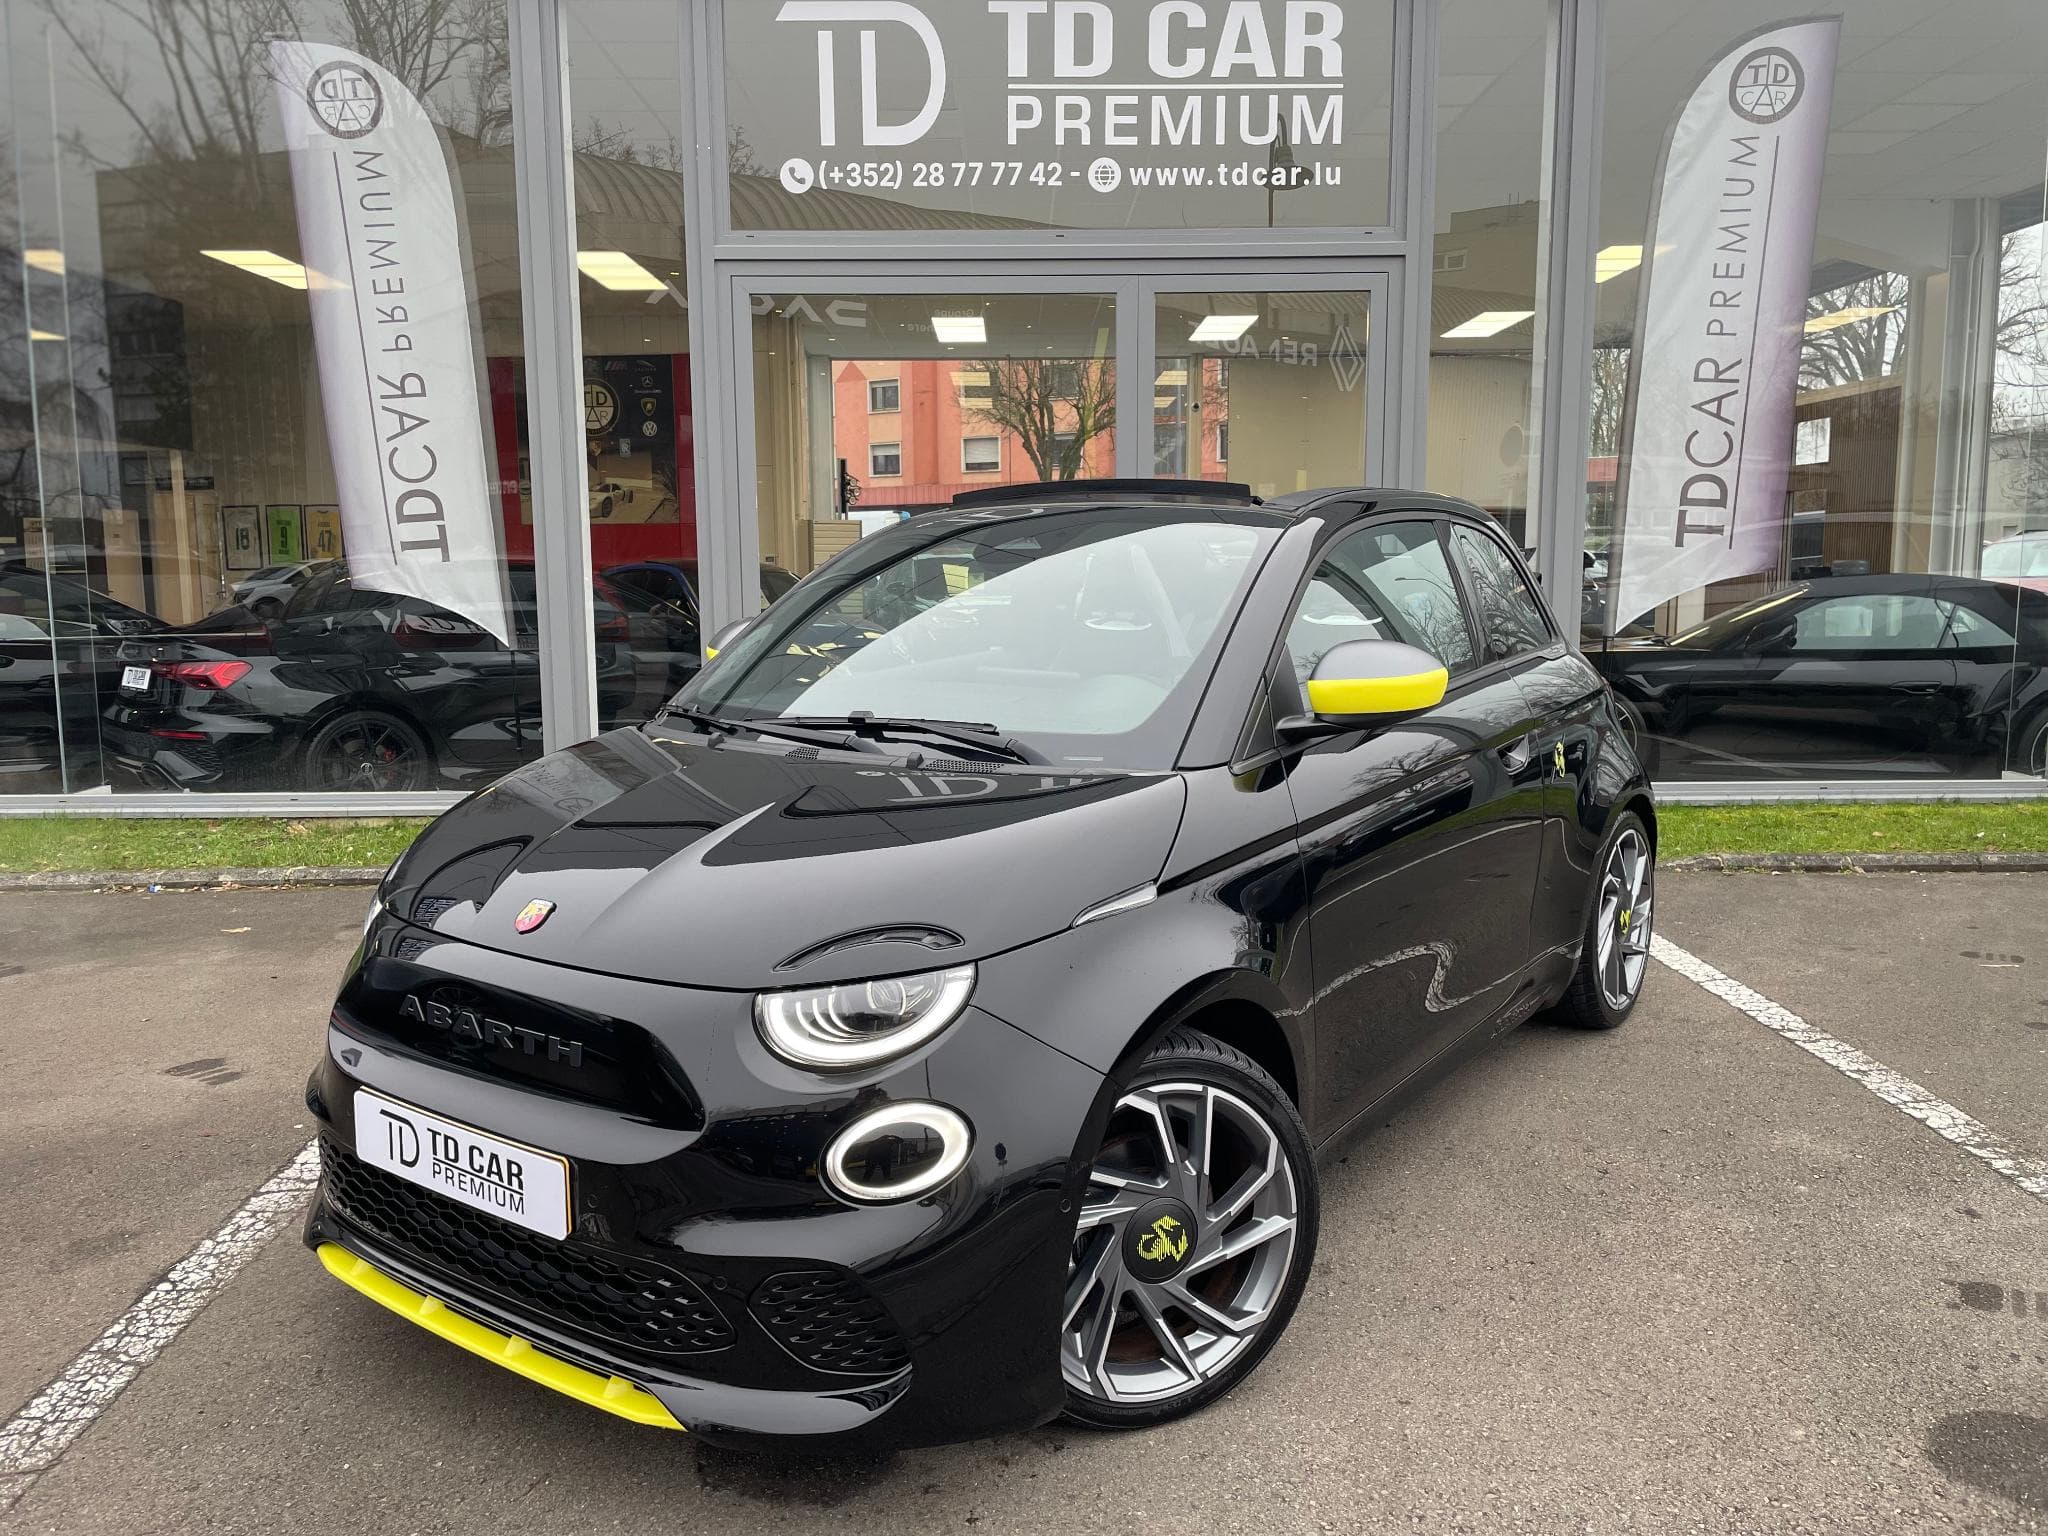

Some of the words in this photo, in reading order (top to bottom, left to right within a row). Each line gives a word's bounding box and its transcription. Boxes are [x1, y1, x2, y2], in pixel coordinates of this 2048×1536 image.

[988, 0, 1114, 78] TD
[1148, 0, 1344, 78] CAR
[1007, 94, 1343, 146] PREMIUM
[819, 160, 903, 189] (+352)
[912, 162, 945, 187] 28
[1029, 162, 1063, 186] 42
[1129, 161, 1341, 186] www.tdcar.lu
[1706, 136, 1760, 336] PREMIUM
[398, 994, 584, 1068] ABARTH
[426, 1126, 460, 1164] TD
[468, 1143, 525, 1192] CAR
[431, 1161, 526, 1216] PREMIUM
